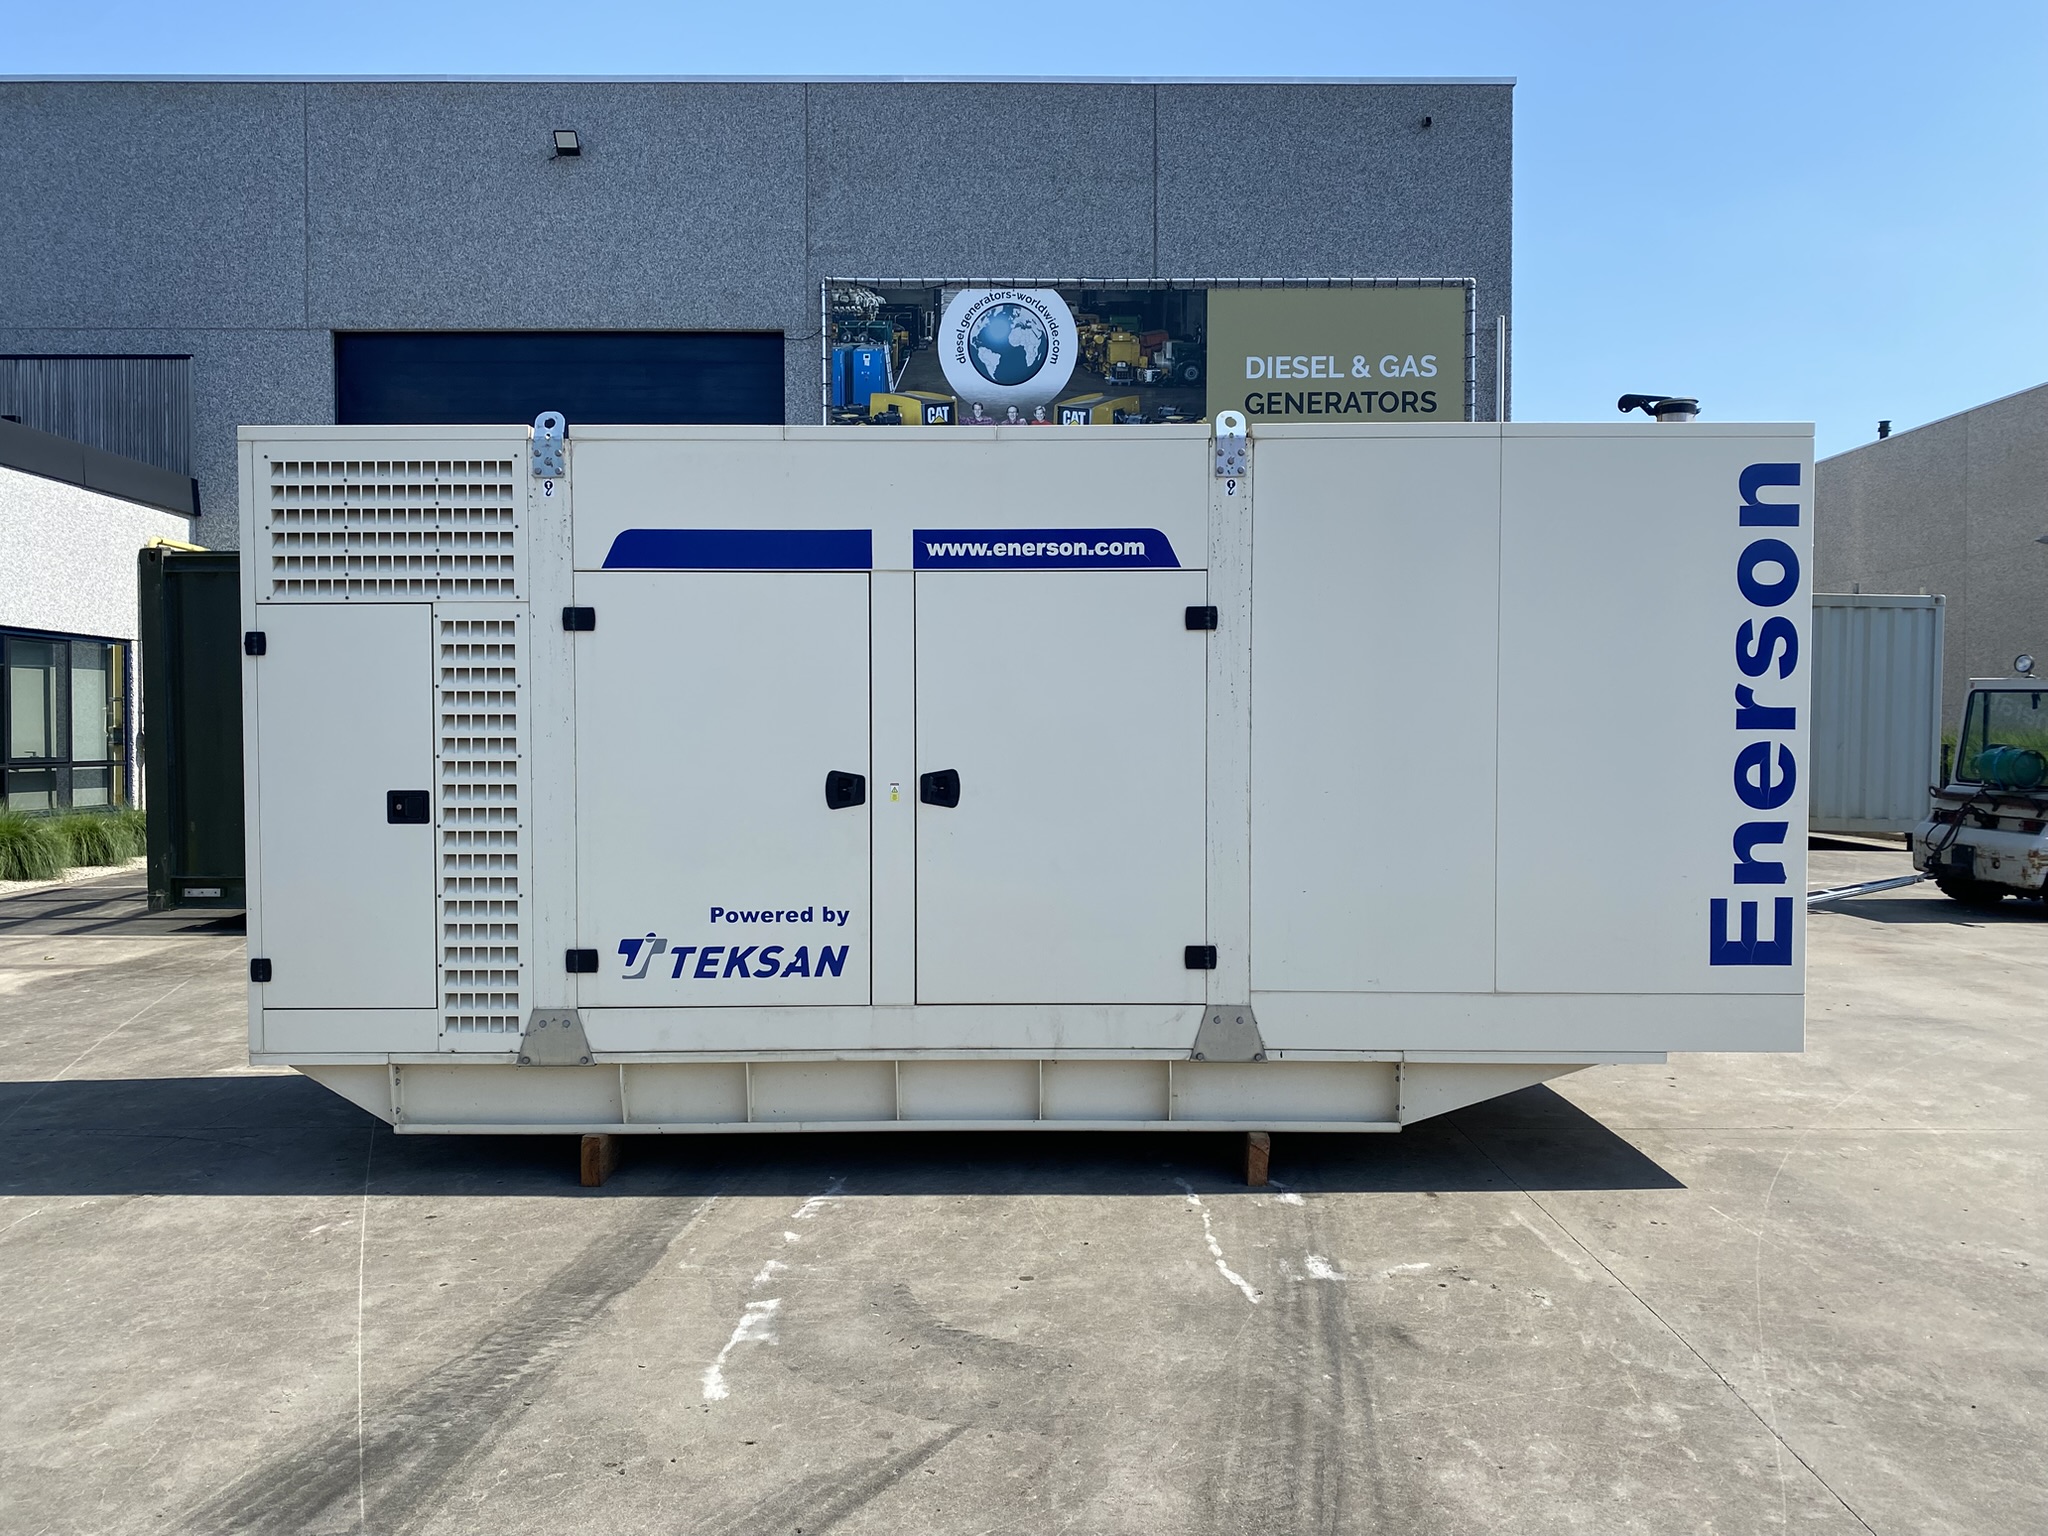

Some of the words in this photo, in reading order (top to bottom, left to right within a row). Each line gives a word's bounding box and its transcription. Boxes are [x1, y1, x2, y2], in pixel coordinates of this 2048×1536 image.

[955, 329, 967, 364] diesel
[1245, 355, 1345, 379] DIESEL
[1351, 354, 1372, 378] &
[1378, 354, 1438, 378] GAS
[927, 406, 950, 424] CAT
[1244, 390, 1438, 415] GENERATORS
[1062, 410, 1086, 425] CAT
[926, 541, 1145, 557] www.enerson.com
[1709, 462, 1801, 967] Enerson
[710, 906, 814, 923] Powered
[822, 906, 850, 927] by
[670, 945, 850, 979] TEKSAN
